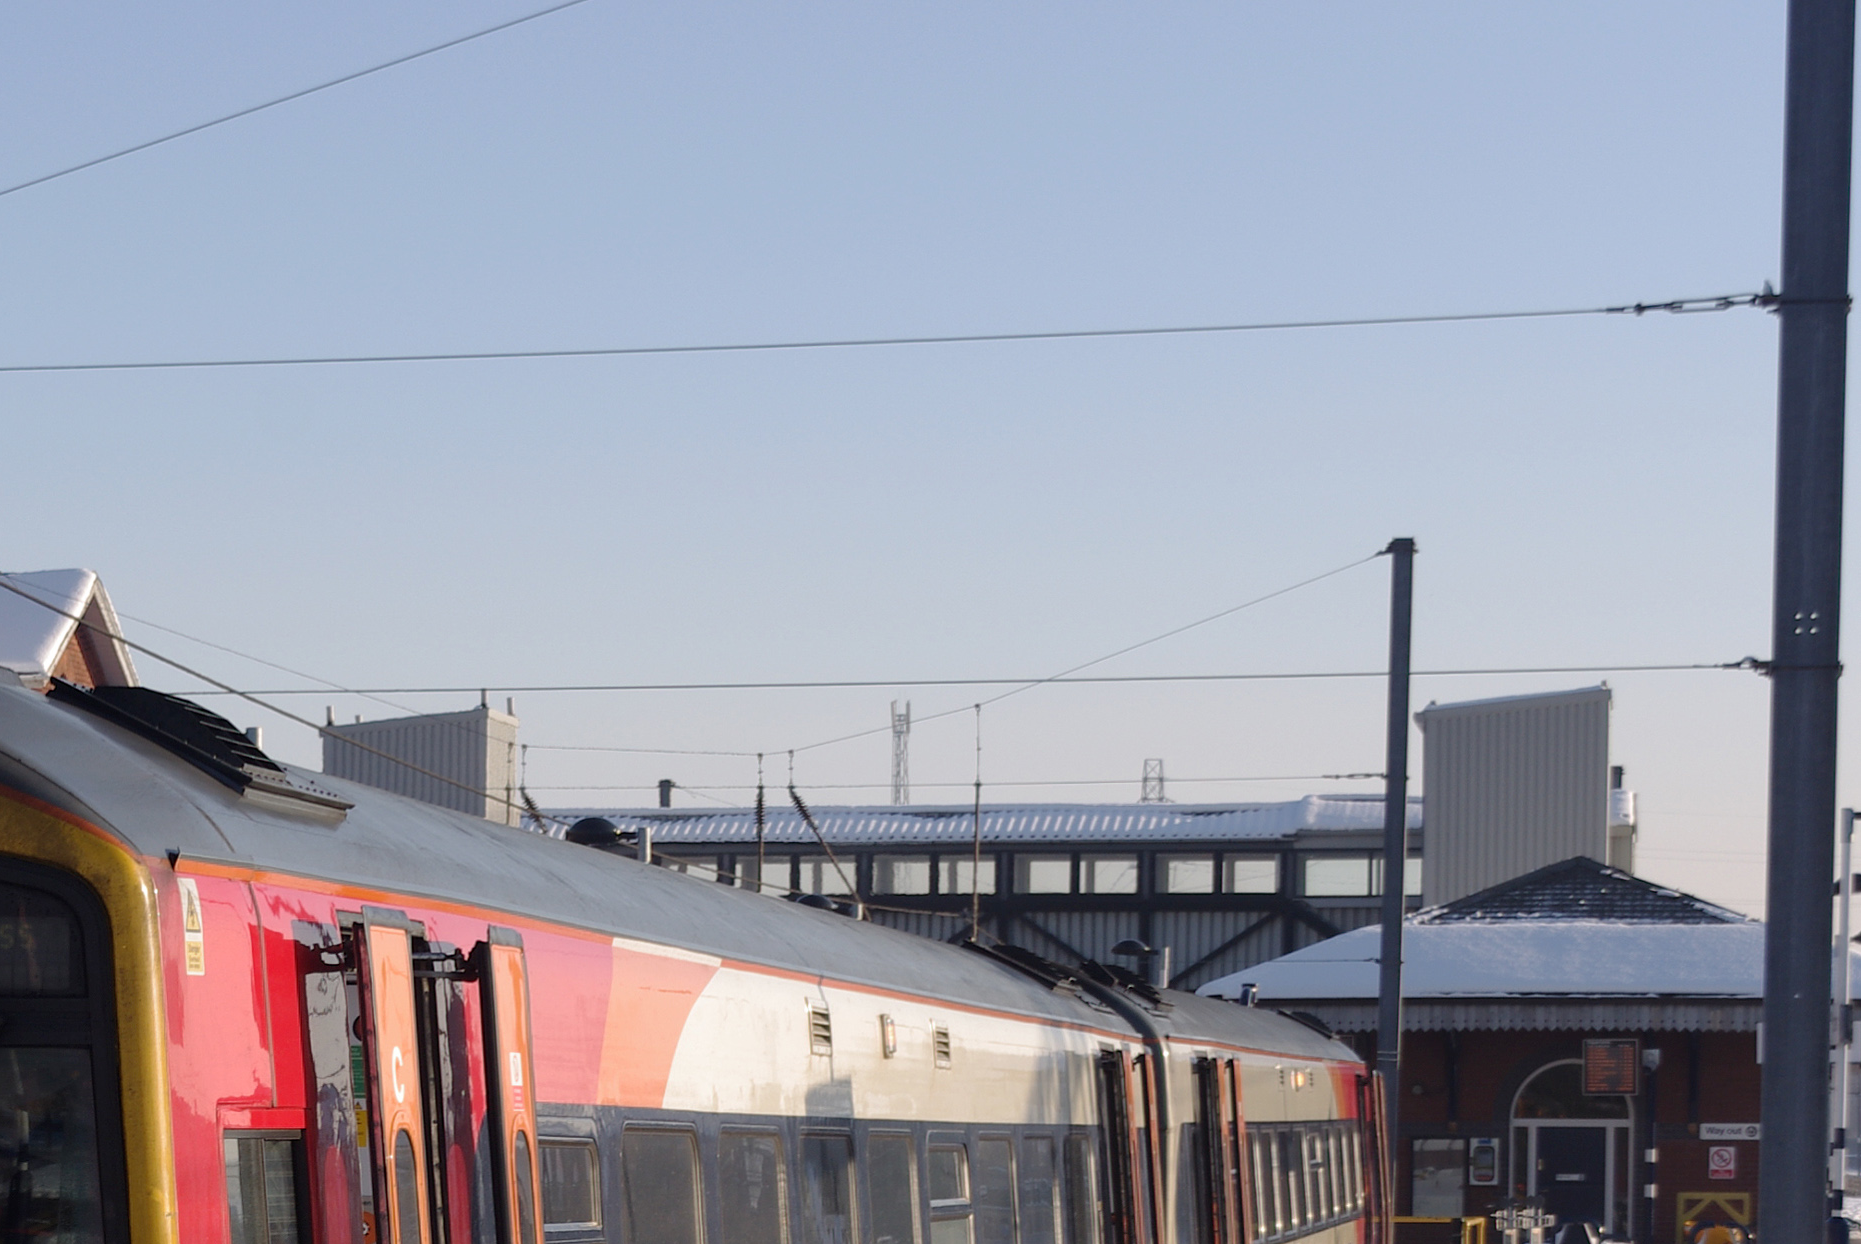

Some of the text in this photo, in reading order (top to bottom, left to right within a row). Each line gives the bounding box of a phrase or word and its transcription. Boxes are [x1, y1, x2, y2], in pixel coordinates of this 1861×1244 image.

[392, 1046, 405, 1103] C
[1705, 1126, 1742, 1136] Way out
